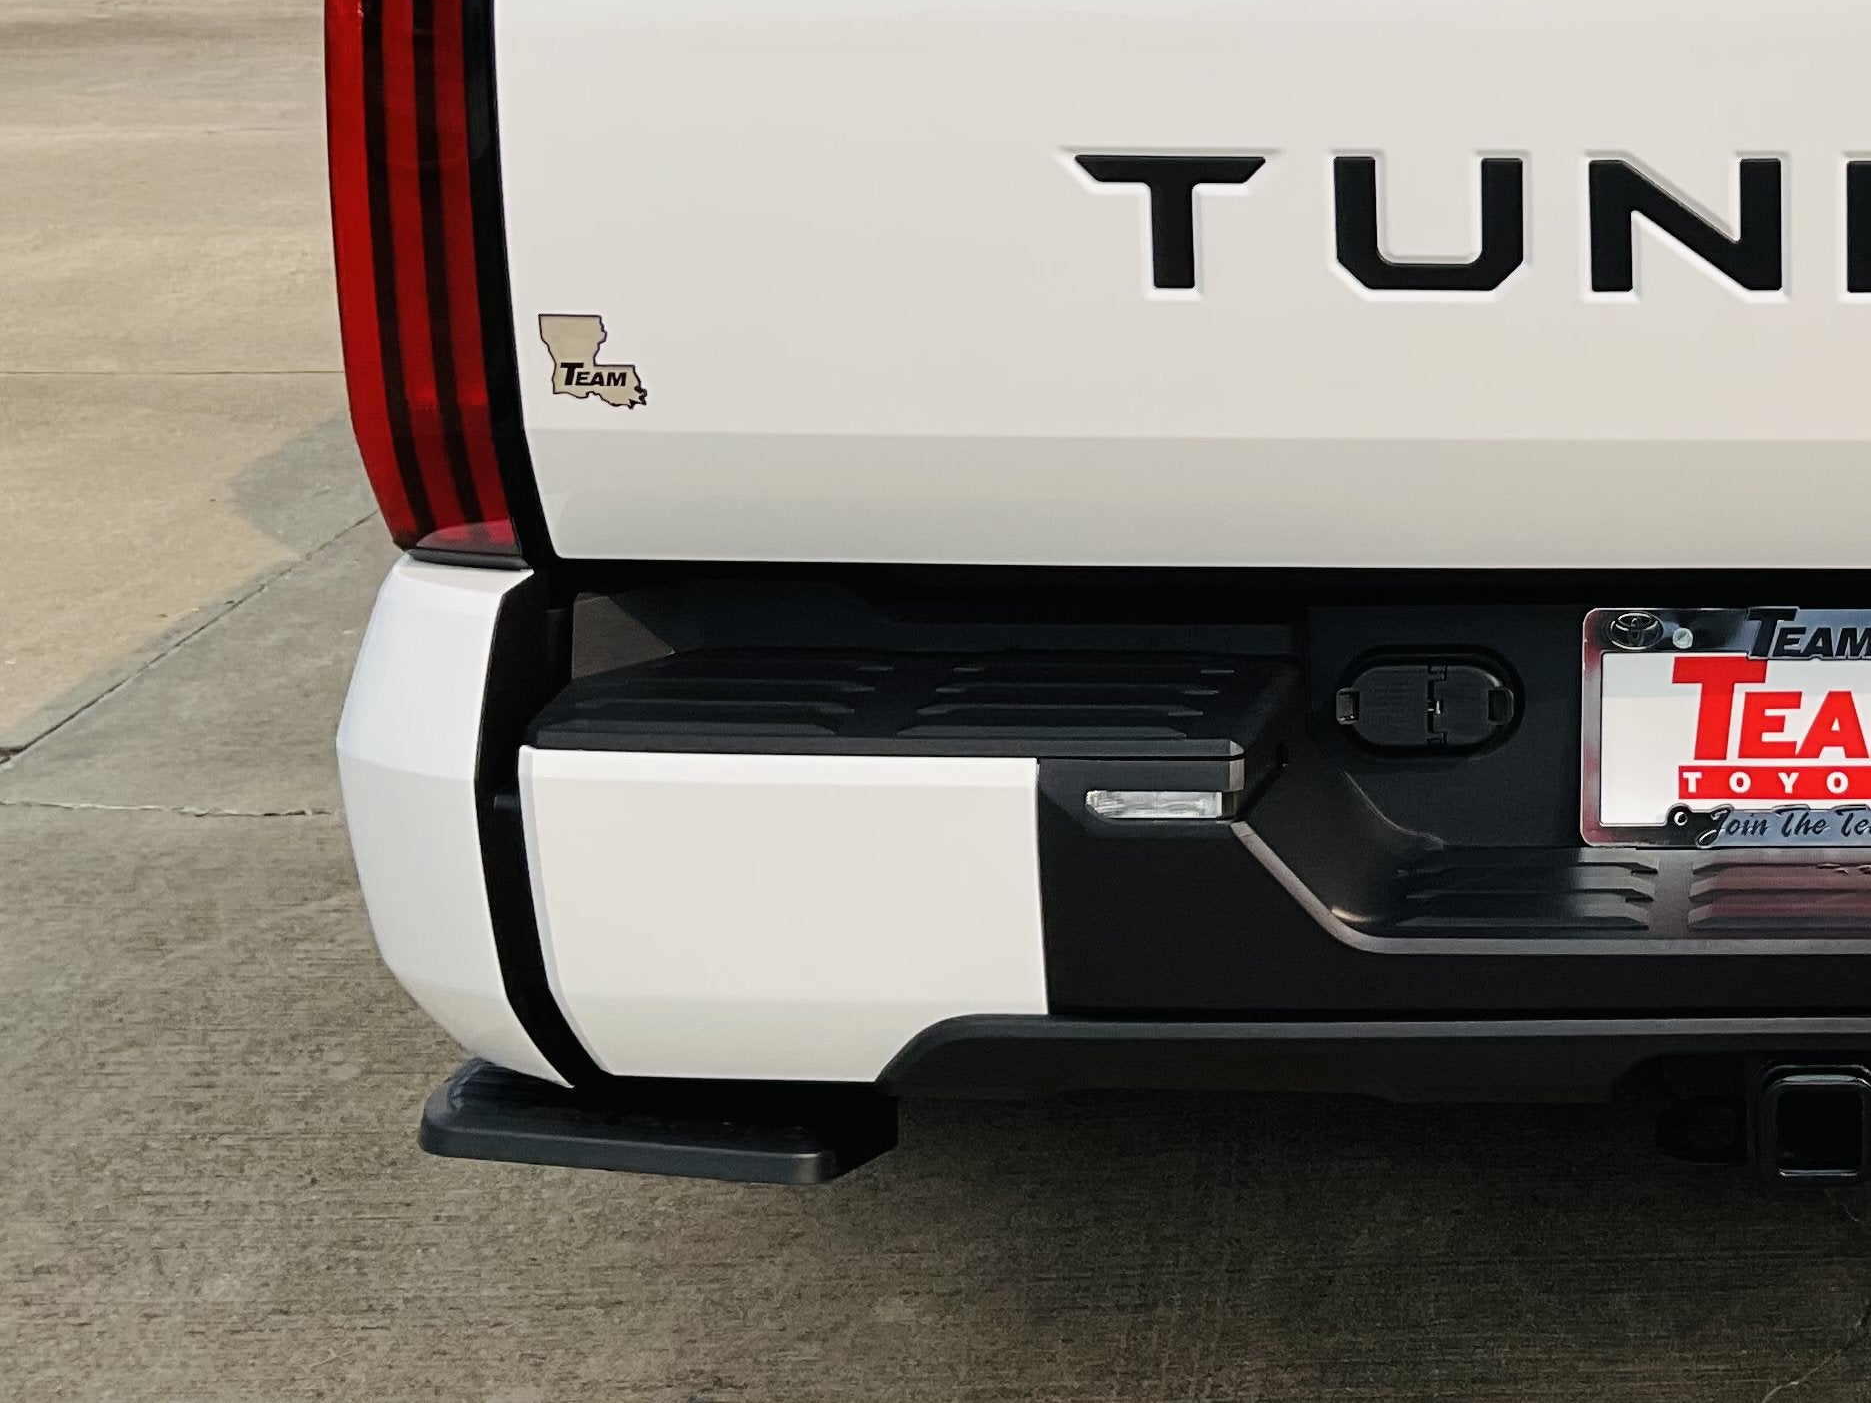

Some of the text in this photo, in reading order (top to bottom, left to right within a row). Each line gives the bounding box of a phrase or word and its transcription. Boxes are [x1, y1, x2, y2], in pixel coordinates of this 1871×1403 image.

[560, 362, 627, 387] TEAM
[1696, 805, 1768, 848] Join
[1774, 805, 1832, 839] The
